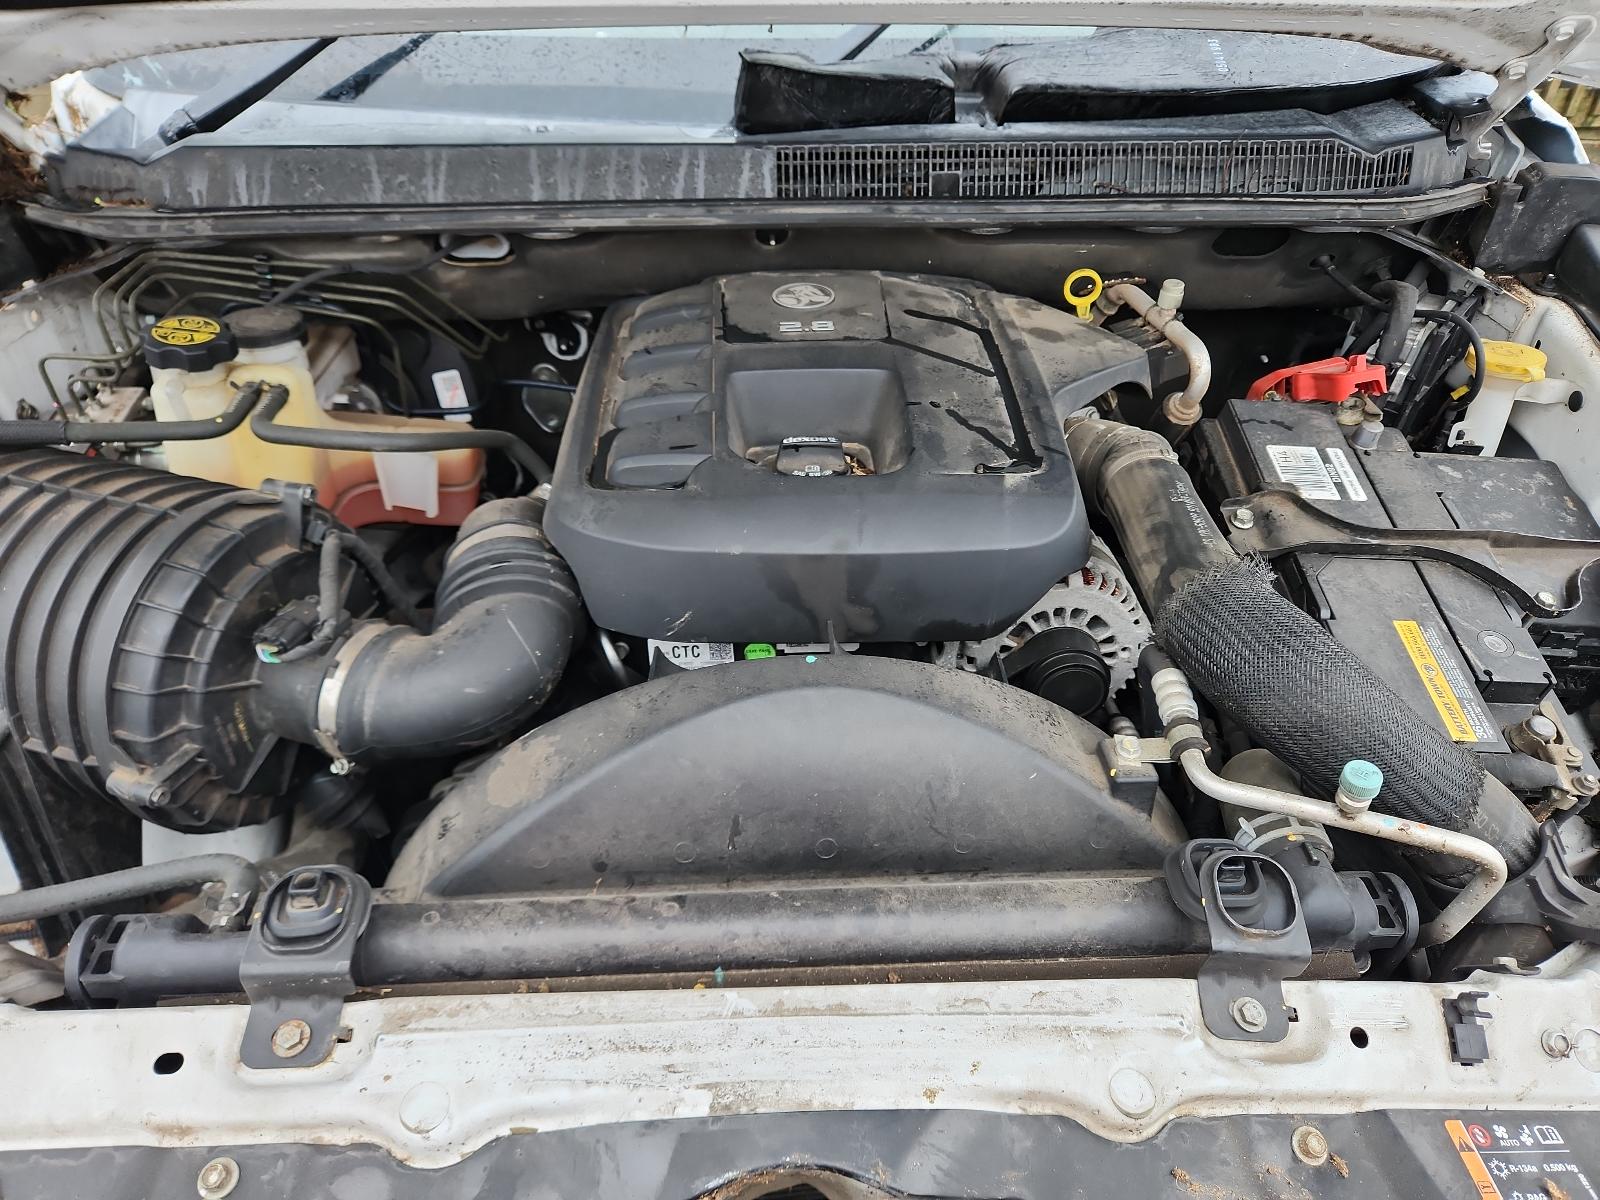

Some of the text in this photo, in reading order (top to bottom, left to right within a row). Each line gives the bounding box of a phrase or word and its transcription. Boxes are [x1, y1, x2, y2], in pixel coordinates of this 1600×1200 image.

[779, 320, 835, 332] 2.8
[672, 645, 701, 658] CTC
[1427, 677, 1445, 698] TOWN
[1442, 701, 1468, 735] BATTERY
[1475, 725, 1488, 738] 36
[1500, 1139, 1520, 1147] AUTO
[1509, 1164, 1538, 1173] R-134a
[1565, 1163, 1579, 1173] kg
